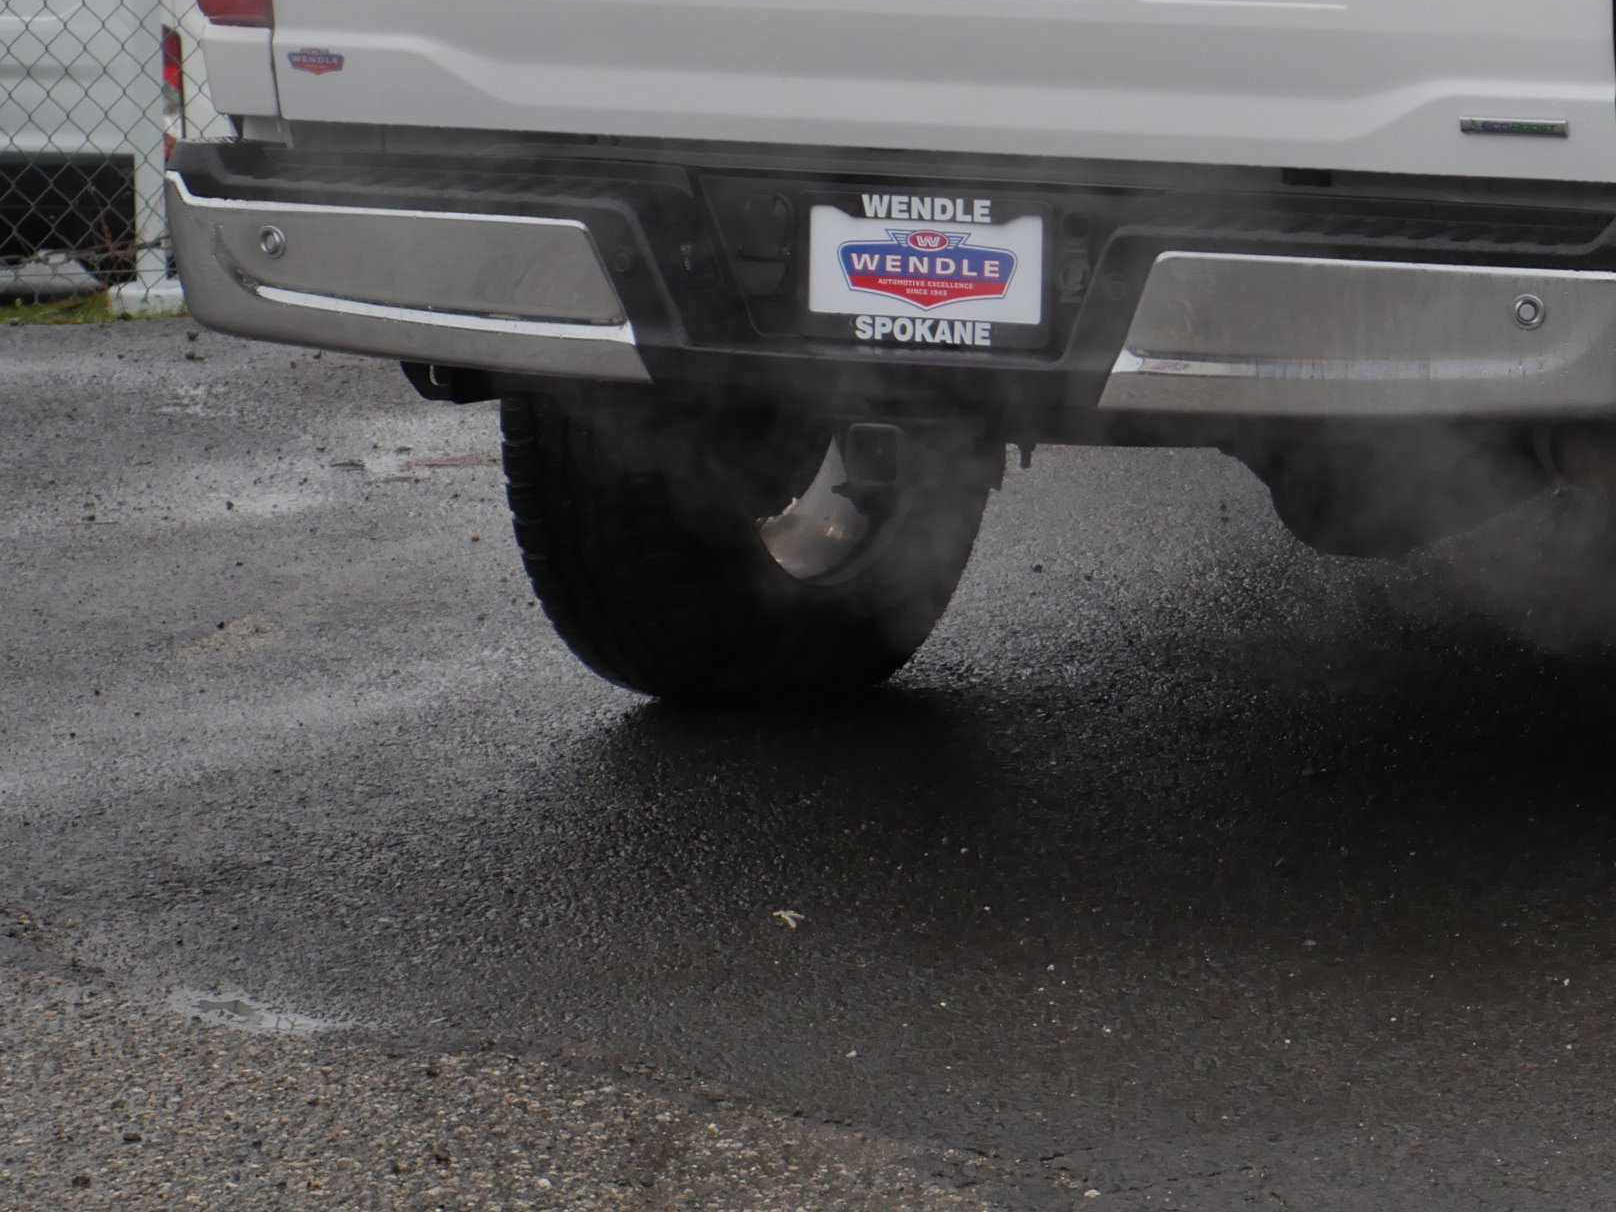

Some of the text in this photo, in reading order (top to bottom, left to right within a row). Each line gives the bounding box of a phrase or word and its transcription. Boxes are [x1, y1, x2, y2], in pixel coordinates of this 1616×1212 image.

[861, 193, 992, 223] WENDLE
[851, 252, 1000, 278] WENDLE
[877, 278, 974, 290] AUTOMOTIVE EXCELLENCE
[905, 287, 928, 296] SINCE
[855, 315, 992, 346] SPOKANE
